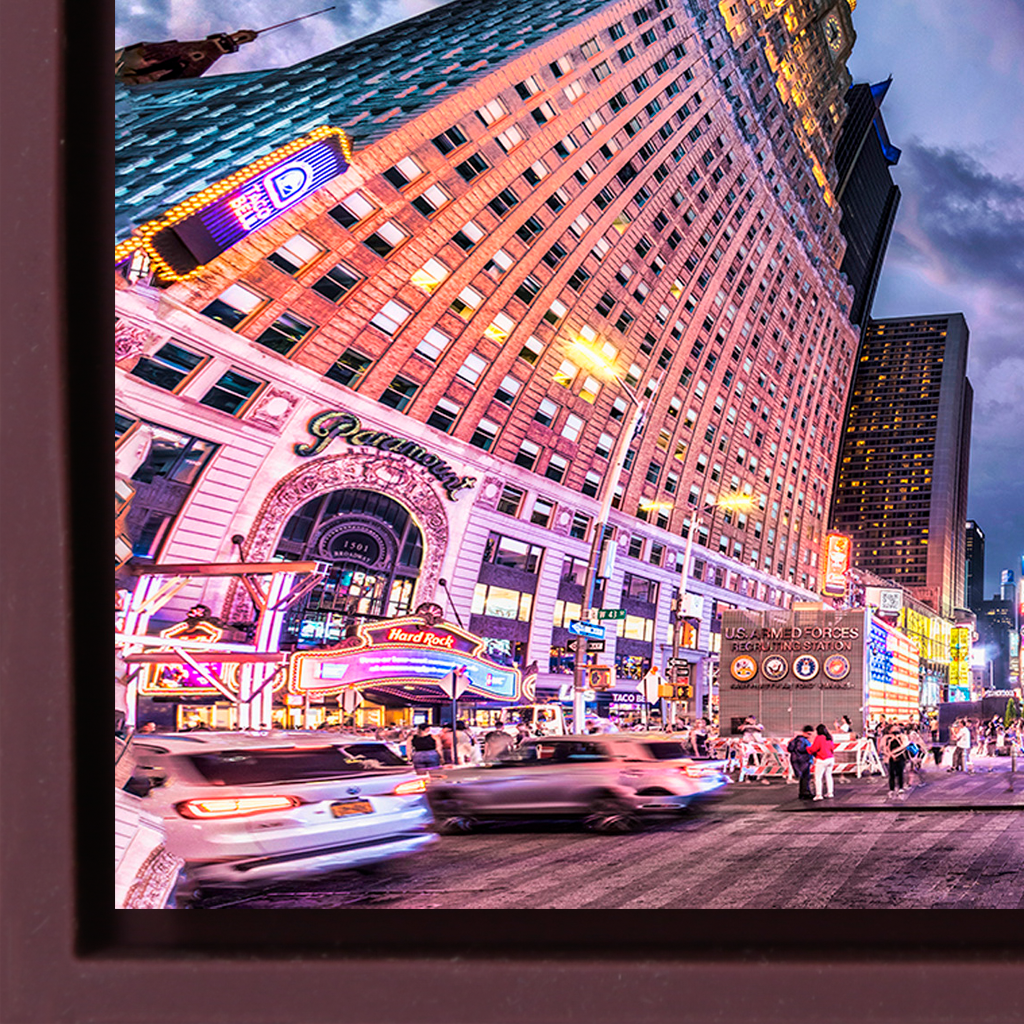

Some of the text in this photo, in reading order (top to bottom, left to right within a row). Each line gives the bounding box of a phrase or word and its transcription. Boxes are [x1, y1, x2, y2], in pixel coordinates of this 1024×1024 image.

[251, 182, 273, 221] TACO
[228, 196, 252, 231] BELL
[293, 410, 477, 503] Paramount
[343, 540, 370, 554] 1501
[333, 549, 372, 564] BROADWAY
[388, 628, 455, 649] Hard Rock
[725, 626, 859, 640] U.S. ARMED FORCES
[732, 641, 851, 652] RECRUITING STATION
[612, 693, 635, 703] TACO
